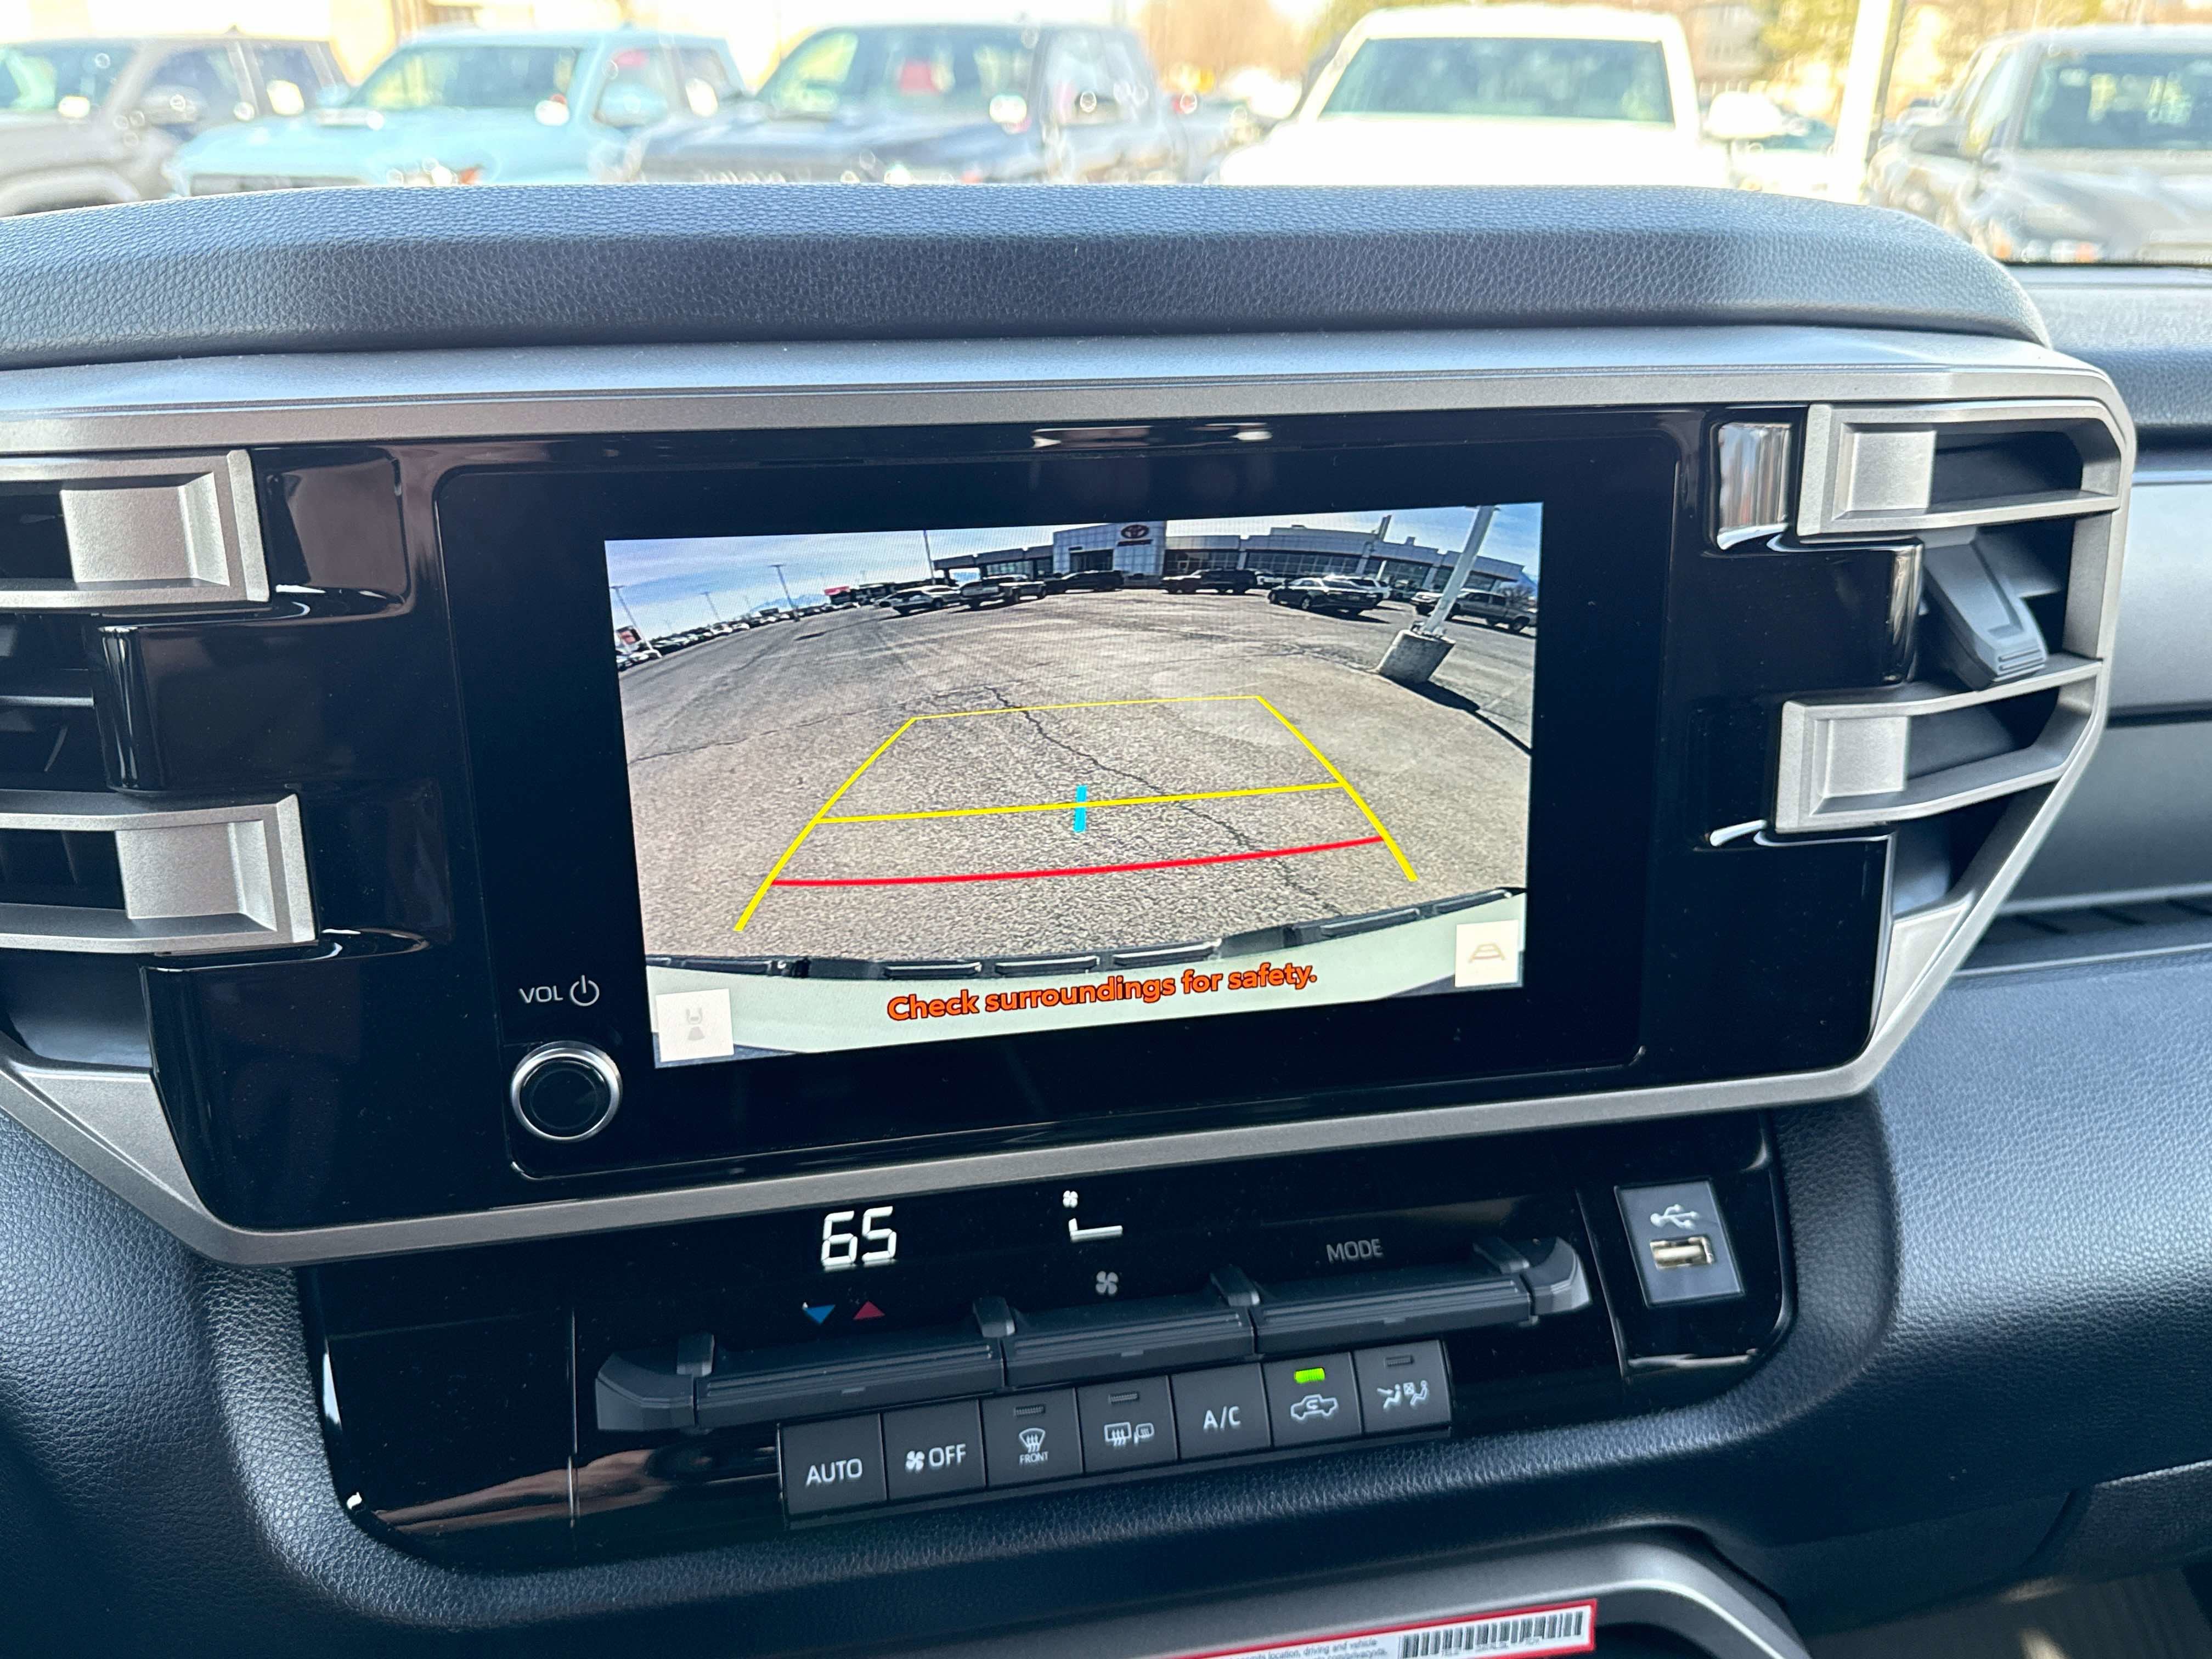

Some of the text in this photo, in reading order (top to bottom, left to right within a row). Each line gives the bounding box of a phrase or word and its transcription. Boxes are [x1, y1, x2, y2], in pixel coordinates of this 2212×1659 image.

[518, 985, 563, 1003] VOL
[887, 962, 1317, 1021] Check surroundings for safety.
[821, 1206, 897, 1267] 65
[1326, 1238, 1383, 1263] MODE
[1203, 1406, 1241, 1431] A/C
[929, 1443, 966, 1467] OFF
[1019, 1451, 1048, 1465] FRONT
[806, 1458, 863, 1486] AUTO
